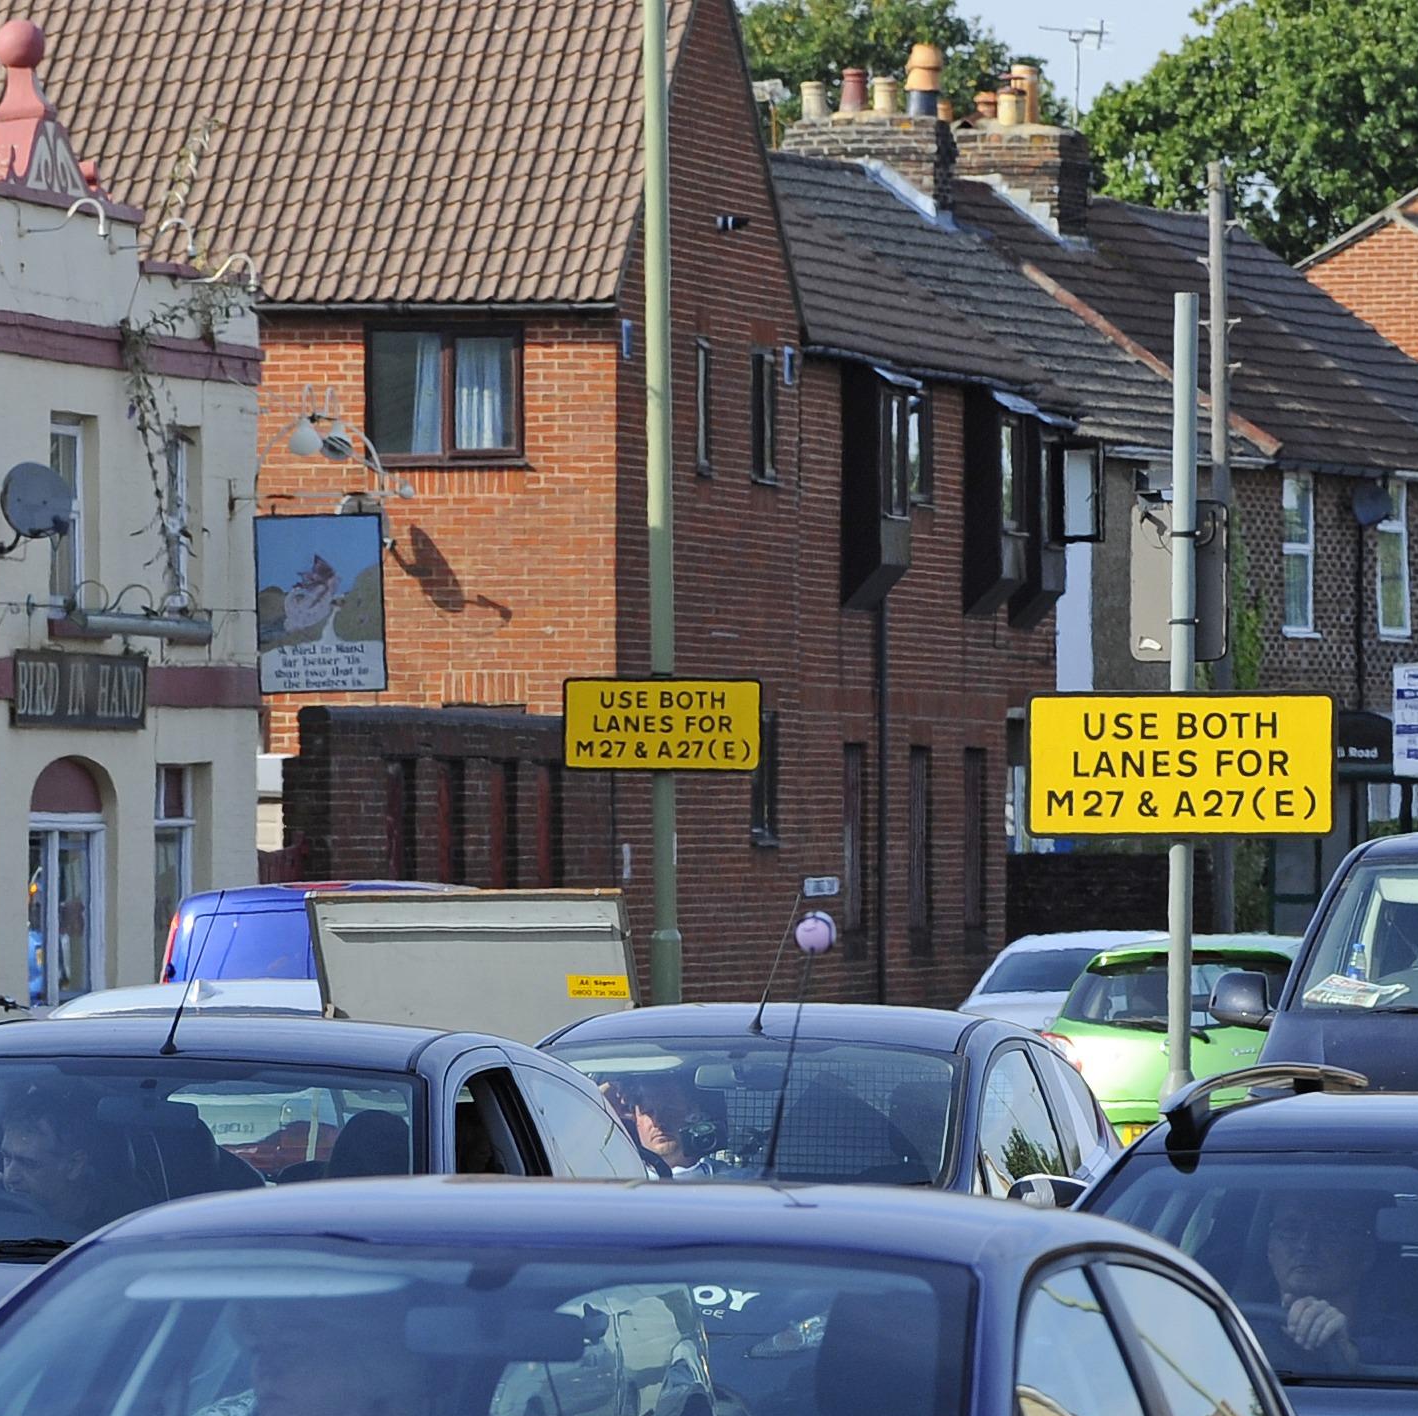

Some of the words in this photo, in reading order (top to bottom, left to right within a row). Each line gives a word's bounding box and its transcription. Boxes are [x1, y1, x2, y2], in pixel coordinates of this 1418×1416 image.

[303, 656, 340, 667] better
[305, 669, 326, 678] two
[17, 661, 60, 716] BIRD
[67, 664, 88, 716] IN
[96, 664, 144, 719] HAND
[284, 680, 300, 689] the
[600, 691, 649, 710] USE
[659, 690, 727, 710] BOTH
[593, 715, 674, 733] LANES
[685, 715, 733, 733] FOR
[1083, 712, 1159, 740] USE
[1177, 712, 1278, 739] BOTH
[576, 740, 627, 758] M27
[635, 742, 649, 758] &
[1348, 746, 1378, 759] Road
[1073, 750, 1198, 778] LANES
[1216, 749, 1290, 776] FOR
[1047, 789, 1125, 817] M27
[1137, 790, 1159, 817] &
